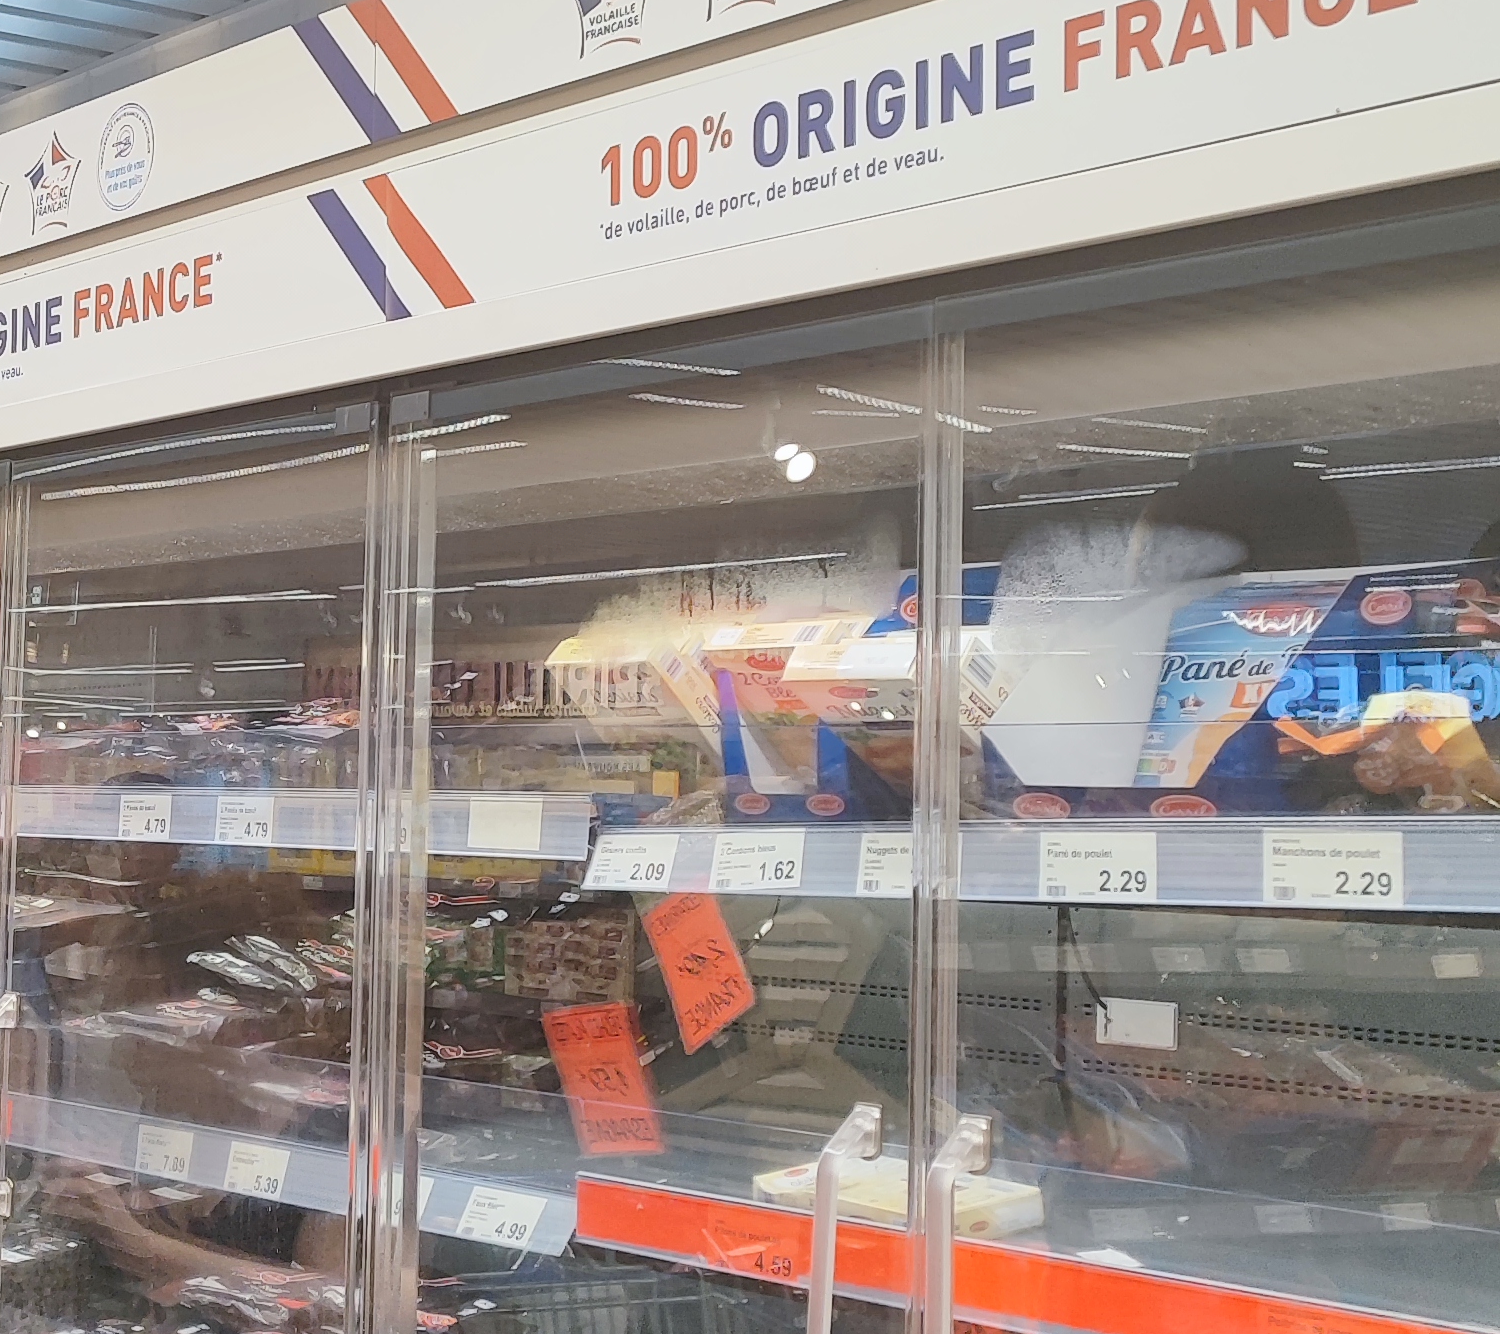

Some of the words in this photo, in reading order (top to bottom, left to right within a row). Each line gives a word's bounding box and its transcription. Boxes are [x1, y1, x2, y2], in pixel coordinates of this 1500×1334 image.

[585, 14, 640, 41] FRANÇAISE
[589, 2, 636, 28] VOLAILLE
[601, 111, 733, 206] 100%
[752, 29, 1035, 169] ORIGINE
[627, 206, 690, 233] volaille,
[695, 199, 715, 218] de
[719, 190, 761, 217] porc,
[766, 182, 787, 202] de
[792, 167, 838, 197] bœuf
[843, 162, 861, 182] et
[866, 156, 888, 178] de
[894, 147, 945, 171] veau.
[1160, 648, 1246, 684] Pané
[1248, 656, 1275, 677] de
[1272, 845, 1327, 859] Manchons
[1329, 847, 1344, 859] de
[1345, 848, 1382, 861] poulet
[629, 862, 667, 881] 2.09
[758, 860, 797, 882] 1.62
[1099, 870, 1148, 894] 2.29
[1335, 871, 1393, 897] 2.29
[253, 1174, 280, 1196] 5.39
[494, 1220, 528, 1242] 4.99
